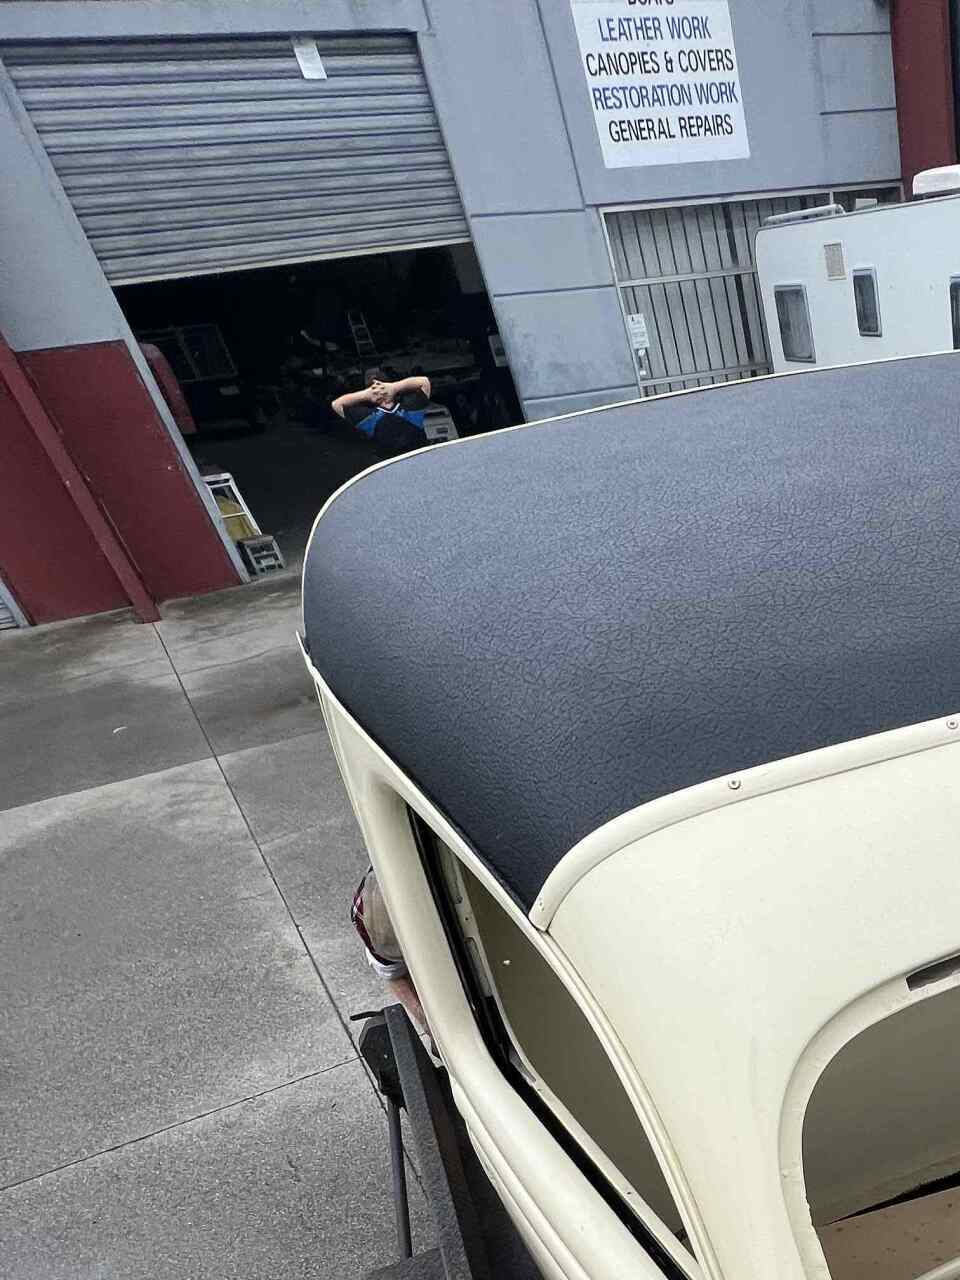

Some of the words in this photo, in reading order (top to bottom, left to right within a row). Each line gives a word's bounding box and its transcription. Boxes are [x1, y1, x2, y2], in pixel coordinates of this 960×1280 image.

[598, 16, 663, 42] LEATHER
[667, 16, 712, 40] WORK
[586, 51, 660, 76] CANOPIES
[665, 50, 674, 73] &
[678, 48, 734, 73] COVERS
[592, 83, 693, 110] RESTORATION
[694, 82, 739, 105] WORK
[608, 117, 676, 143] GENERAL
[678, 114, 734, 138] REPAIRS
